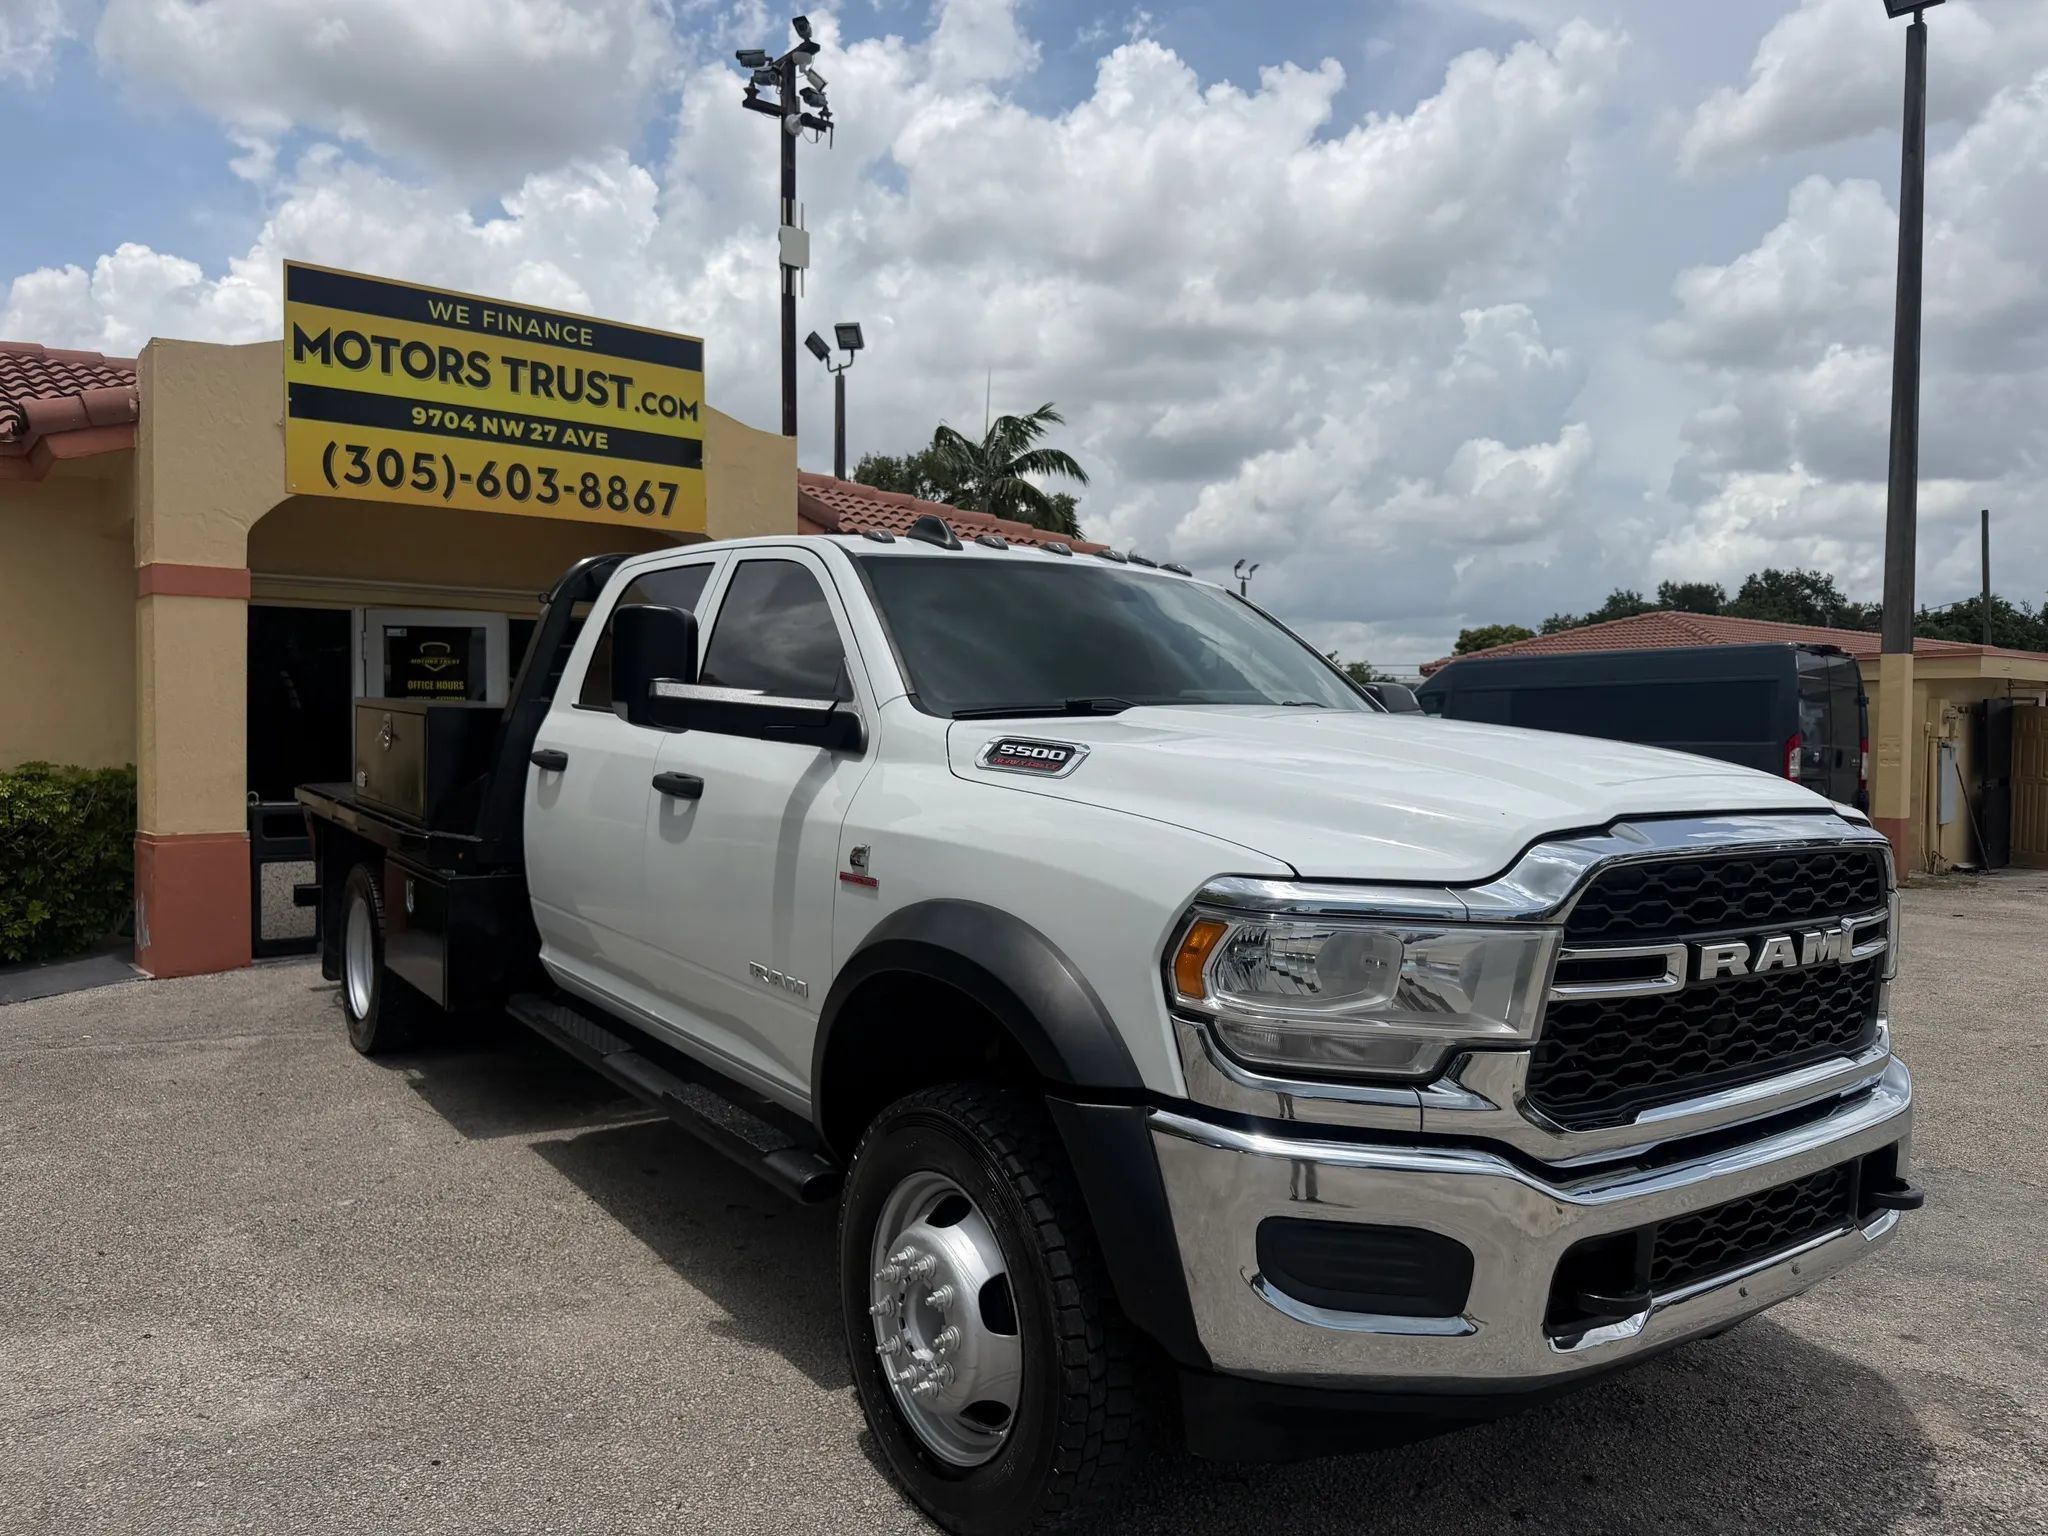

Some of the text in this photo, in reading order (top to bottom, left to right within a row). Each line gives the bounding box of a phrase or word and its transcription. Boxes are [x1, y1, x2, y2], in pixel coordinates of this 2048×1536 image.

[428, 300, 593, 346] WE FINANCE
[293, 321, 491, 389] MOTORS
[411, 406, 608, 450] 9704 NW 27 AVE
[322, 440, 679, 517] (305)-603-8867
[408, 680, 464, 690] OFFICE HOURS
[1000, 744, 1066, 761] 5500
[1699, 928, 1842, 980] RAM
[750, 960, 808, 998] RAM
